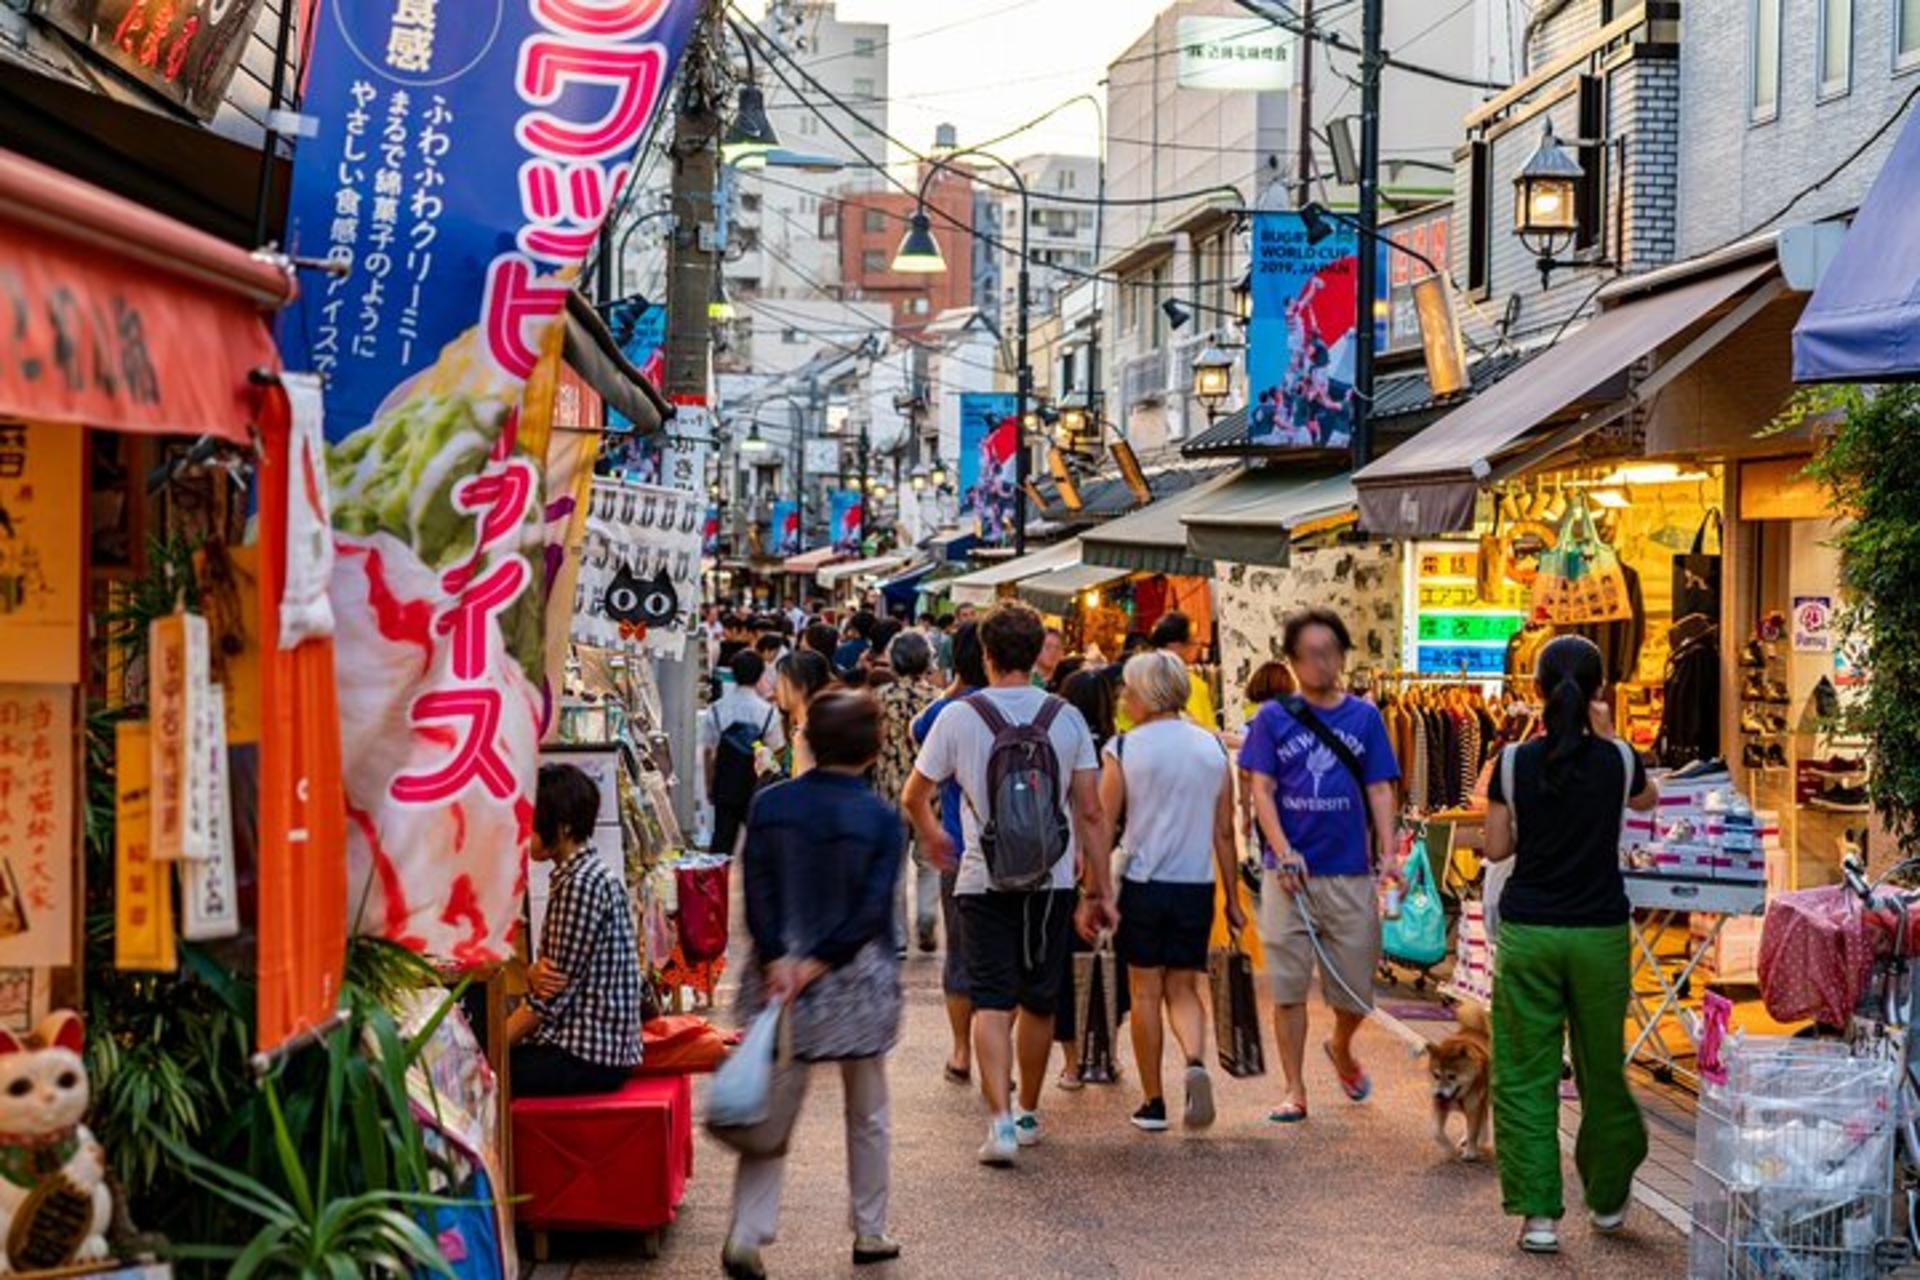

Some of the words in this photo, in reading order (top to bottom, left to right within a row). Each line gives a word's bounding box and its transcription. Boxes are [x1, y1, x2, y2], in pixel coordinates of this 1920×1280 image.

[352, 90, 410, 358] まるで綿菓子のように
[399, 94, 454, 366] ふわふわクリーミー
[1261, 246, 1316, 259] WORLD
[1320, 247, 1350, 259] CUP
[1276, 731, 1316, 763] NEW
[1282, 796, 1350, 811] UNIVERSITY
